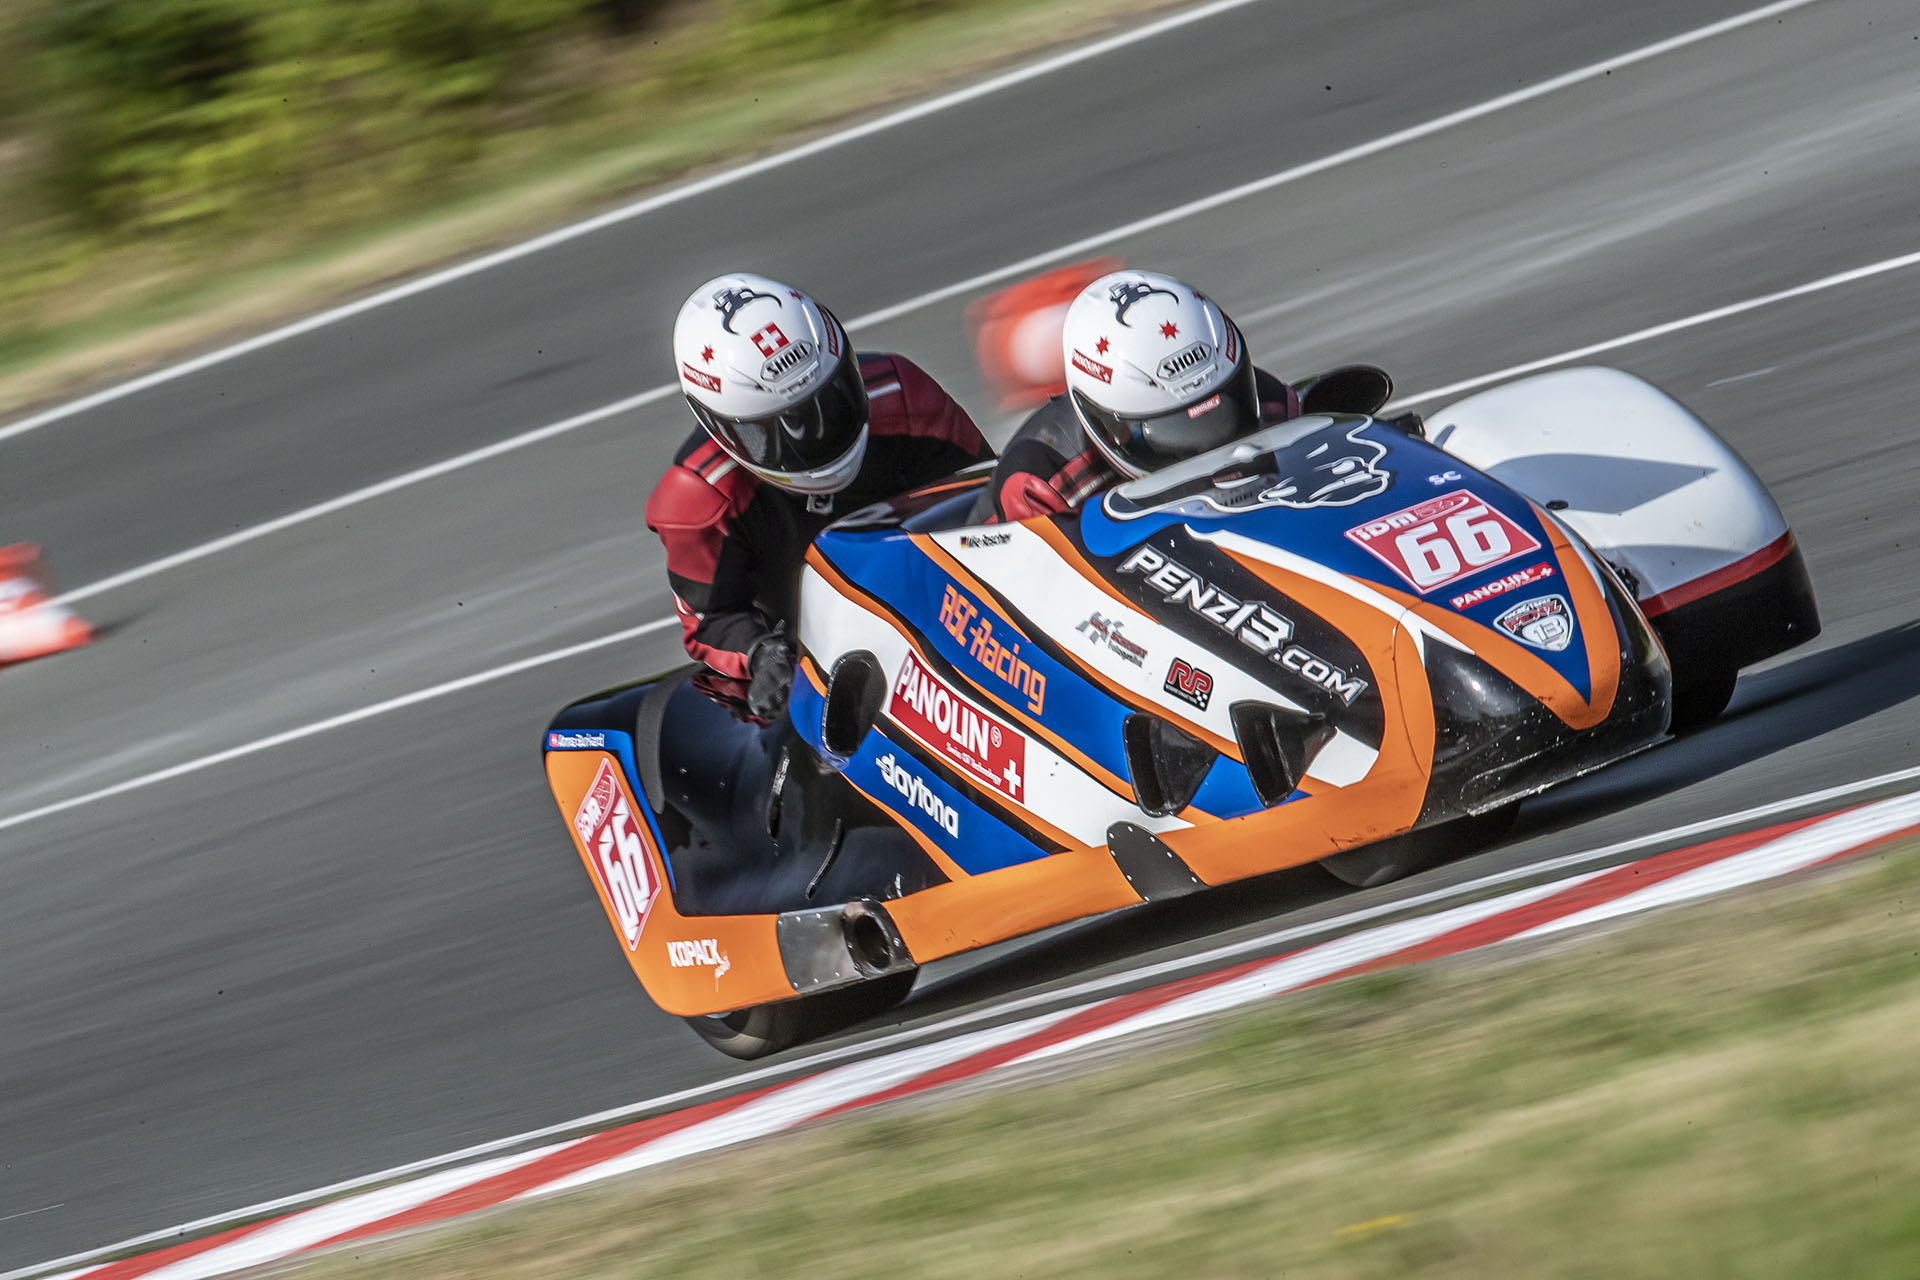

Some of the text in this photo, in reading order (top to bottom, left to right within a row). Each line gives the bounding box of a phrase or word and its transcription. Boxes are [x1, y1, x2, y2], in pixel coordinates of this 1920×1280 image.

[764, 342, 811, 376] SHOEI
[1162, 344, 1208, 376] SHOEI
[1395, 505, 1511, 586] 66
[1453, 571, 1531, 608] PANOLIN
[895, 656, 990, 761] PANOLIN
[875, 753, 959, 839] daytona
[598, 796, 651, 941] 66
